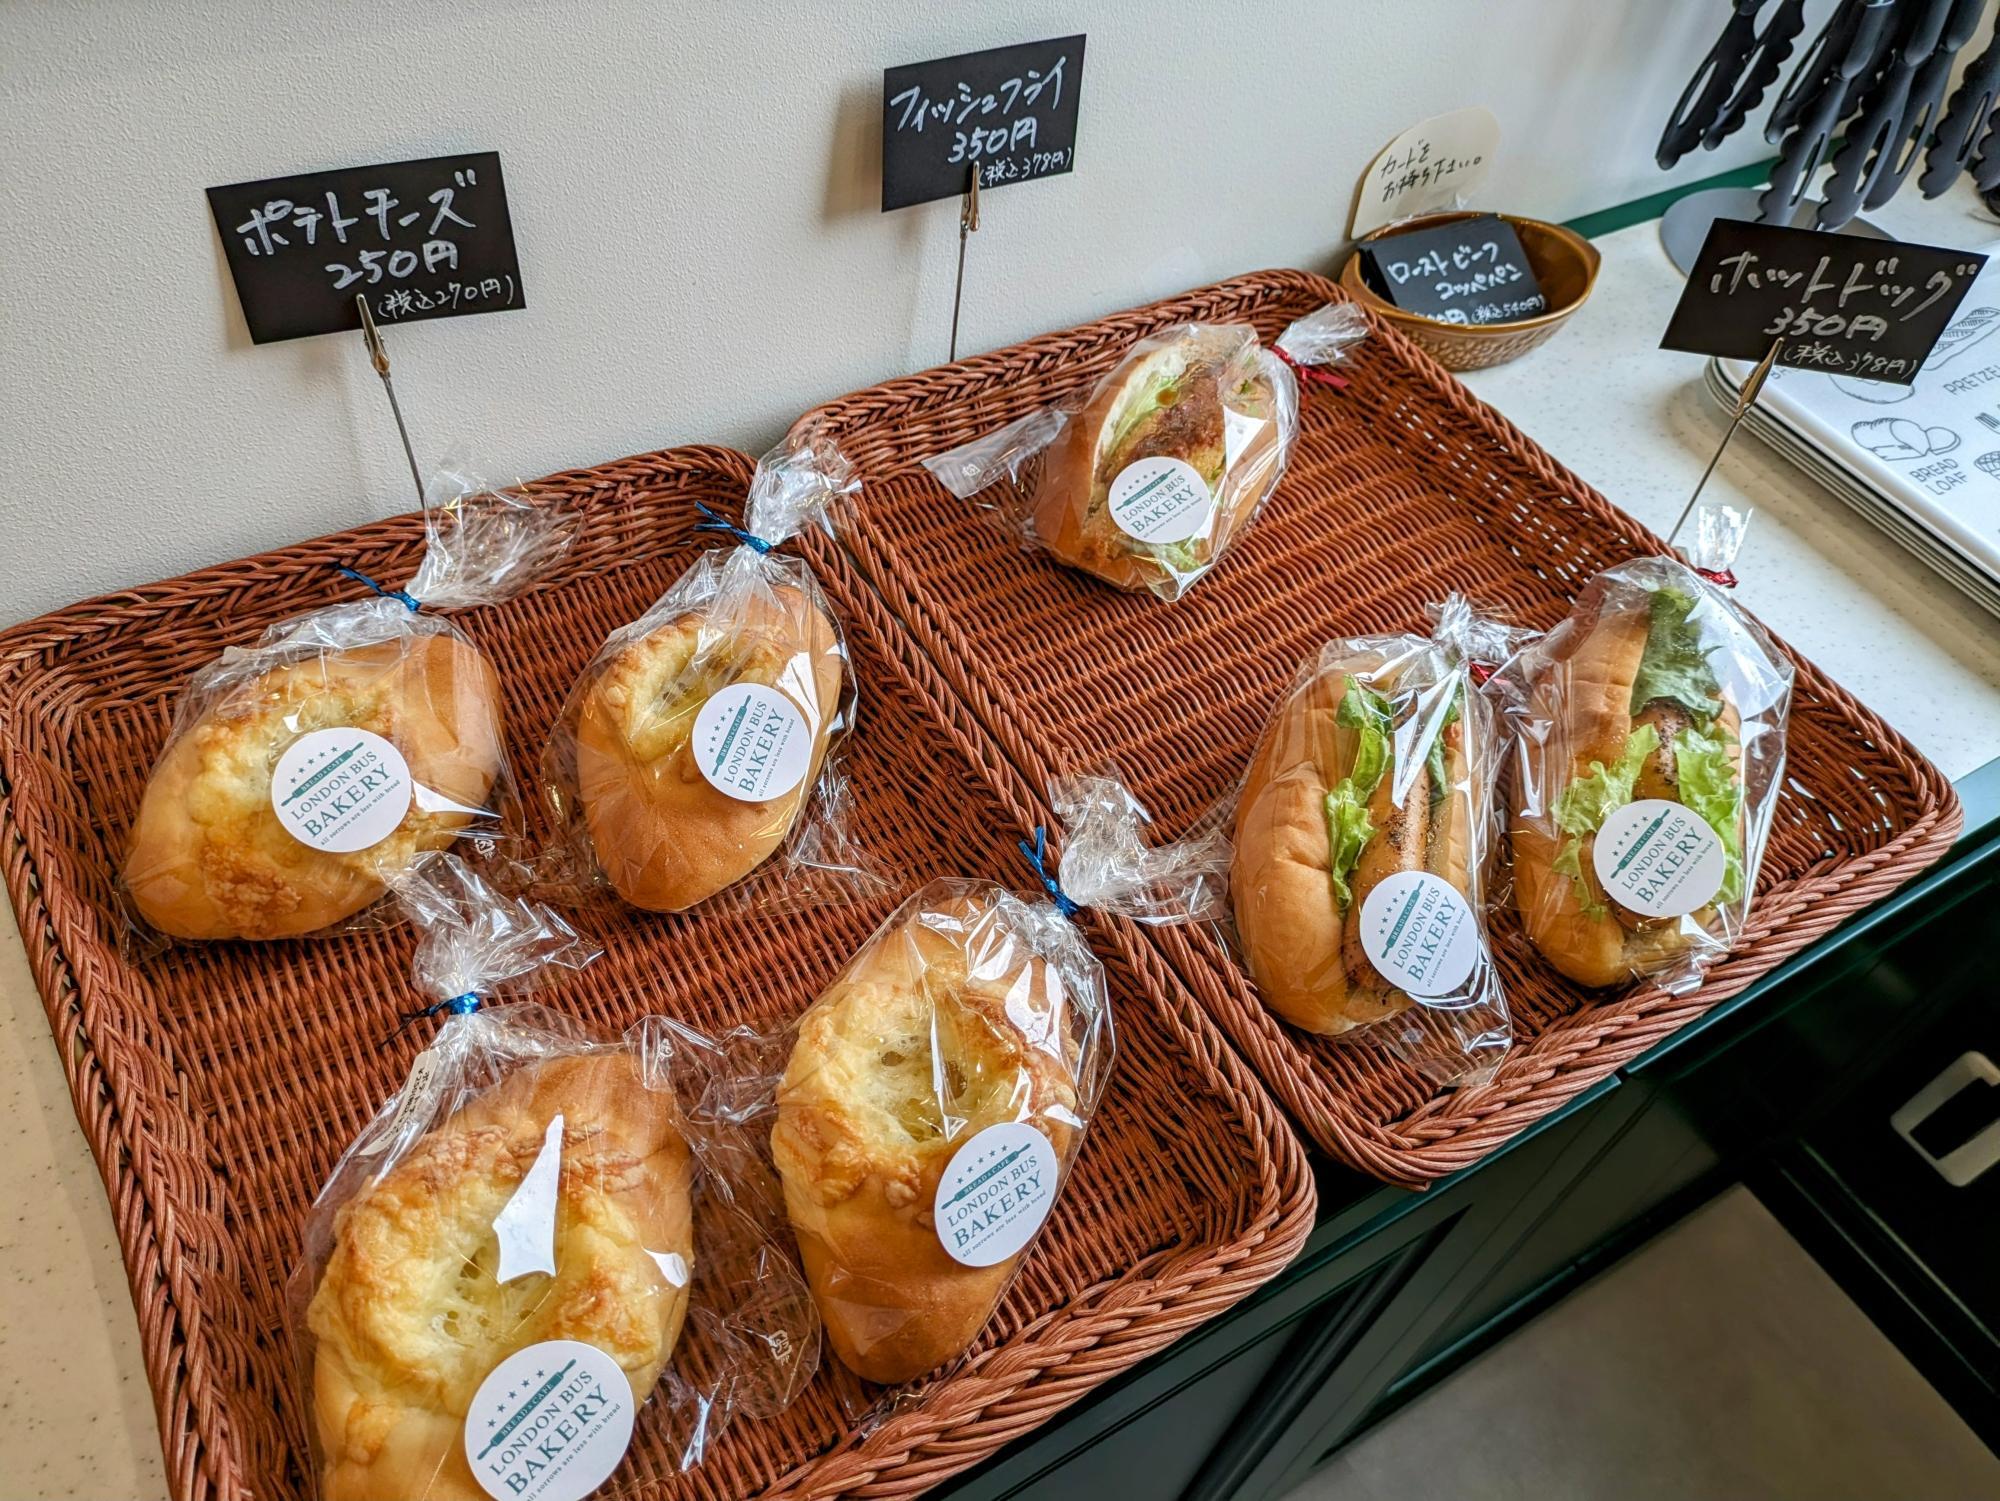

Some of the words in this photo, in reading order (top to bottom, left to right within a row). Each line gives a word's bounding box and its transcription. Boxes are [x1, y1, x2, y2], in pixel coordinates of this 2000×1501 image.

[890, 56, 1066, 132] フィッシュフライ
[948, 116, 1037, 163] 350円
[1381, 139, 1430, 178] カードを
[237, 168, 477, 255] ポテトチーズ
[1382, 156, 1482, 202] お持ち下さい。
[324, 240, 459, 289] 250円
[378, 274, 515, 319] (税込270円)
[1387, 241, 1499, 284] ローストビーフ
[1434, 262, 1522, 300] コッペパン
[1710, 251, 1977, 321] ホットドッグ
[1763, 306, 1888, 341] 350円
[1783, 341, 1918, 379] (税込378円)
[1122, 489, 1166, 521] LONDON
[1166, 475, 1185, 492] BUS
[1909, 458, 1959, 483] BREAD
[1925, 472, 1969, 496] LOAF
[1131, 485, 1194, 532] BAKERY
[723, 727, 755, 784] LONDON
[749, 701, 767, 727] BUS
[738, 708, 784, 793] BAKERY
[291, 771, 351, 820] LONDON
[349, 751, 377, 775] BUS
[303, 763, 390, 837] BAKERY
[1622, 839, 1667, 890] LONDON
[1663, 817, 1686, 841] BUS
[1636, 827, 1702, 903] BAKERY
[1393, 912, 1427, 969] LONDON
[1422, 887, 1440, 913] BUS
[1407, 896, 1456, 982] BAKERY
[947, 1176, 1009, 1227] LONDON
[1011, 1156, 1037, 1181] BUS
[954, 1170, 1040, 1248] BAKERY
[489, 1402, 561, 1475] LONDON
[559, 1371, 592, 1404] BUS
[501, 1409, 528, 1436] BREAD
[532, 1384, 552, 1404] CAFE
[505, 1384, 608, 1495] BAKERY
[537, 1467, 562, 1493] sorrows
[563, 1454, 573, 1466] are
[572, 1440, 587, 1454] less
[588, 1424, 602, 1438] with
[601, 1403, 621, 1423] bread
